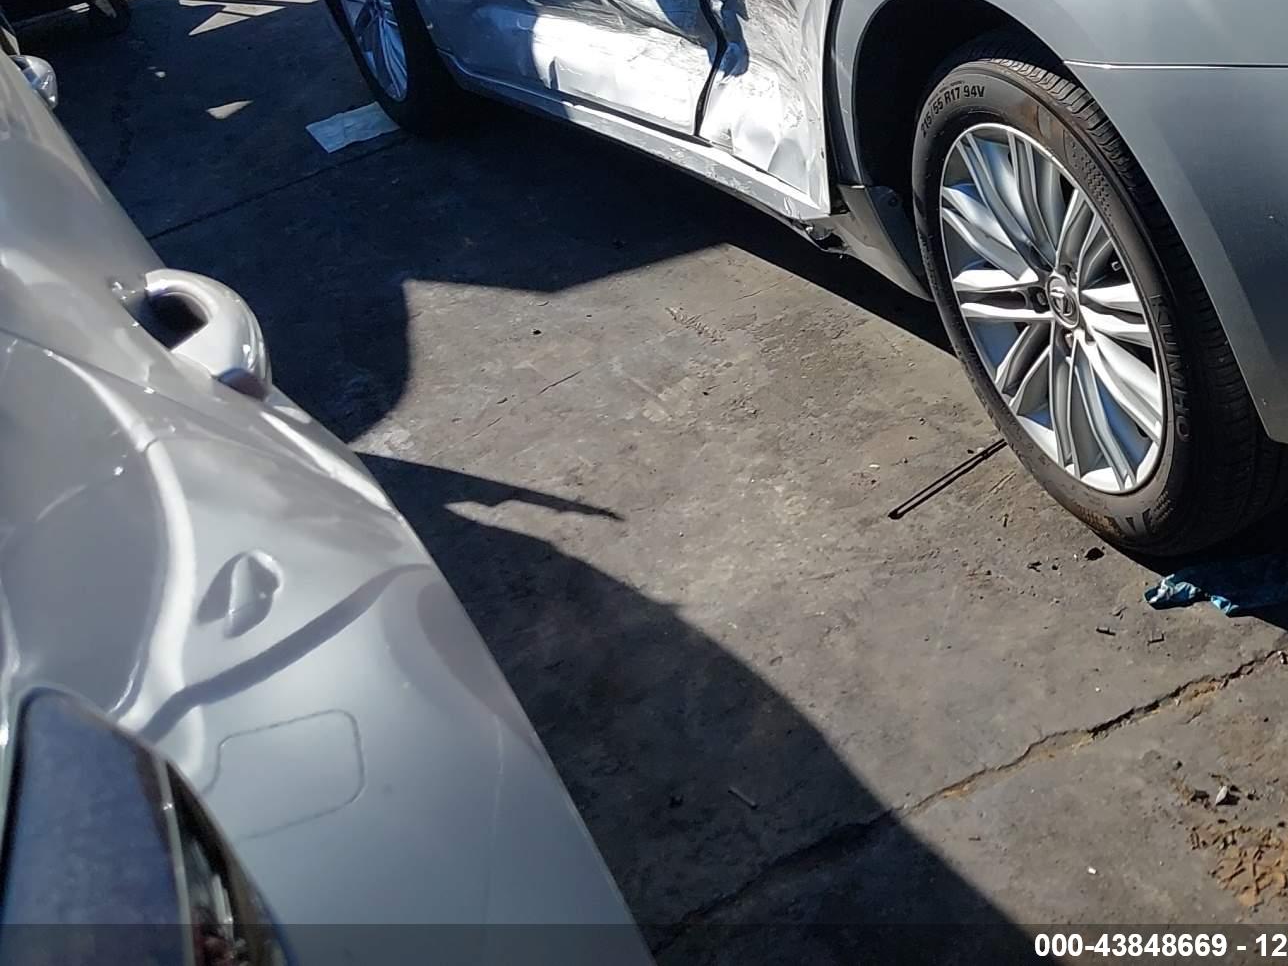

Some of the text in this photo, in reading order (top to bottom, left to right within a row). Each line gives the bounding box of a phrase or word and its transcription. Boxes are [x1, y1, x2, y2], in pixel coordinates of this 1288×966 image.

[944, 87, 961, 105] R17
[964, 85, 986, 98] 94V
[1149, 292, 1192, 443] KUMHO
